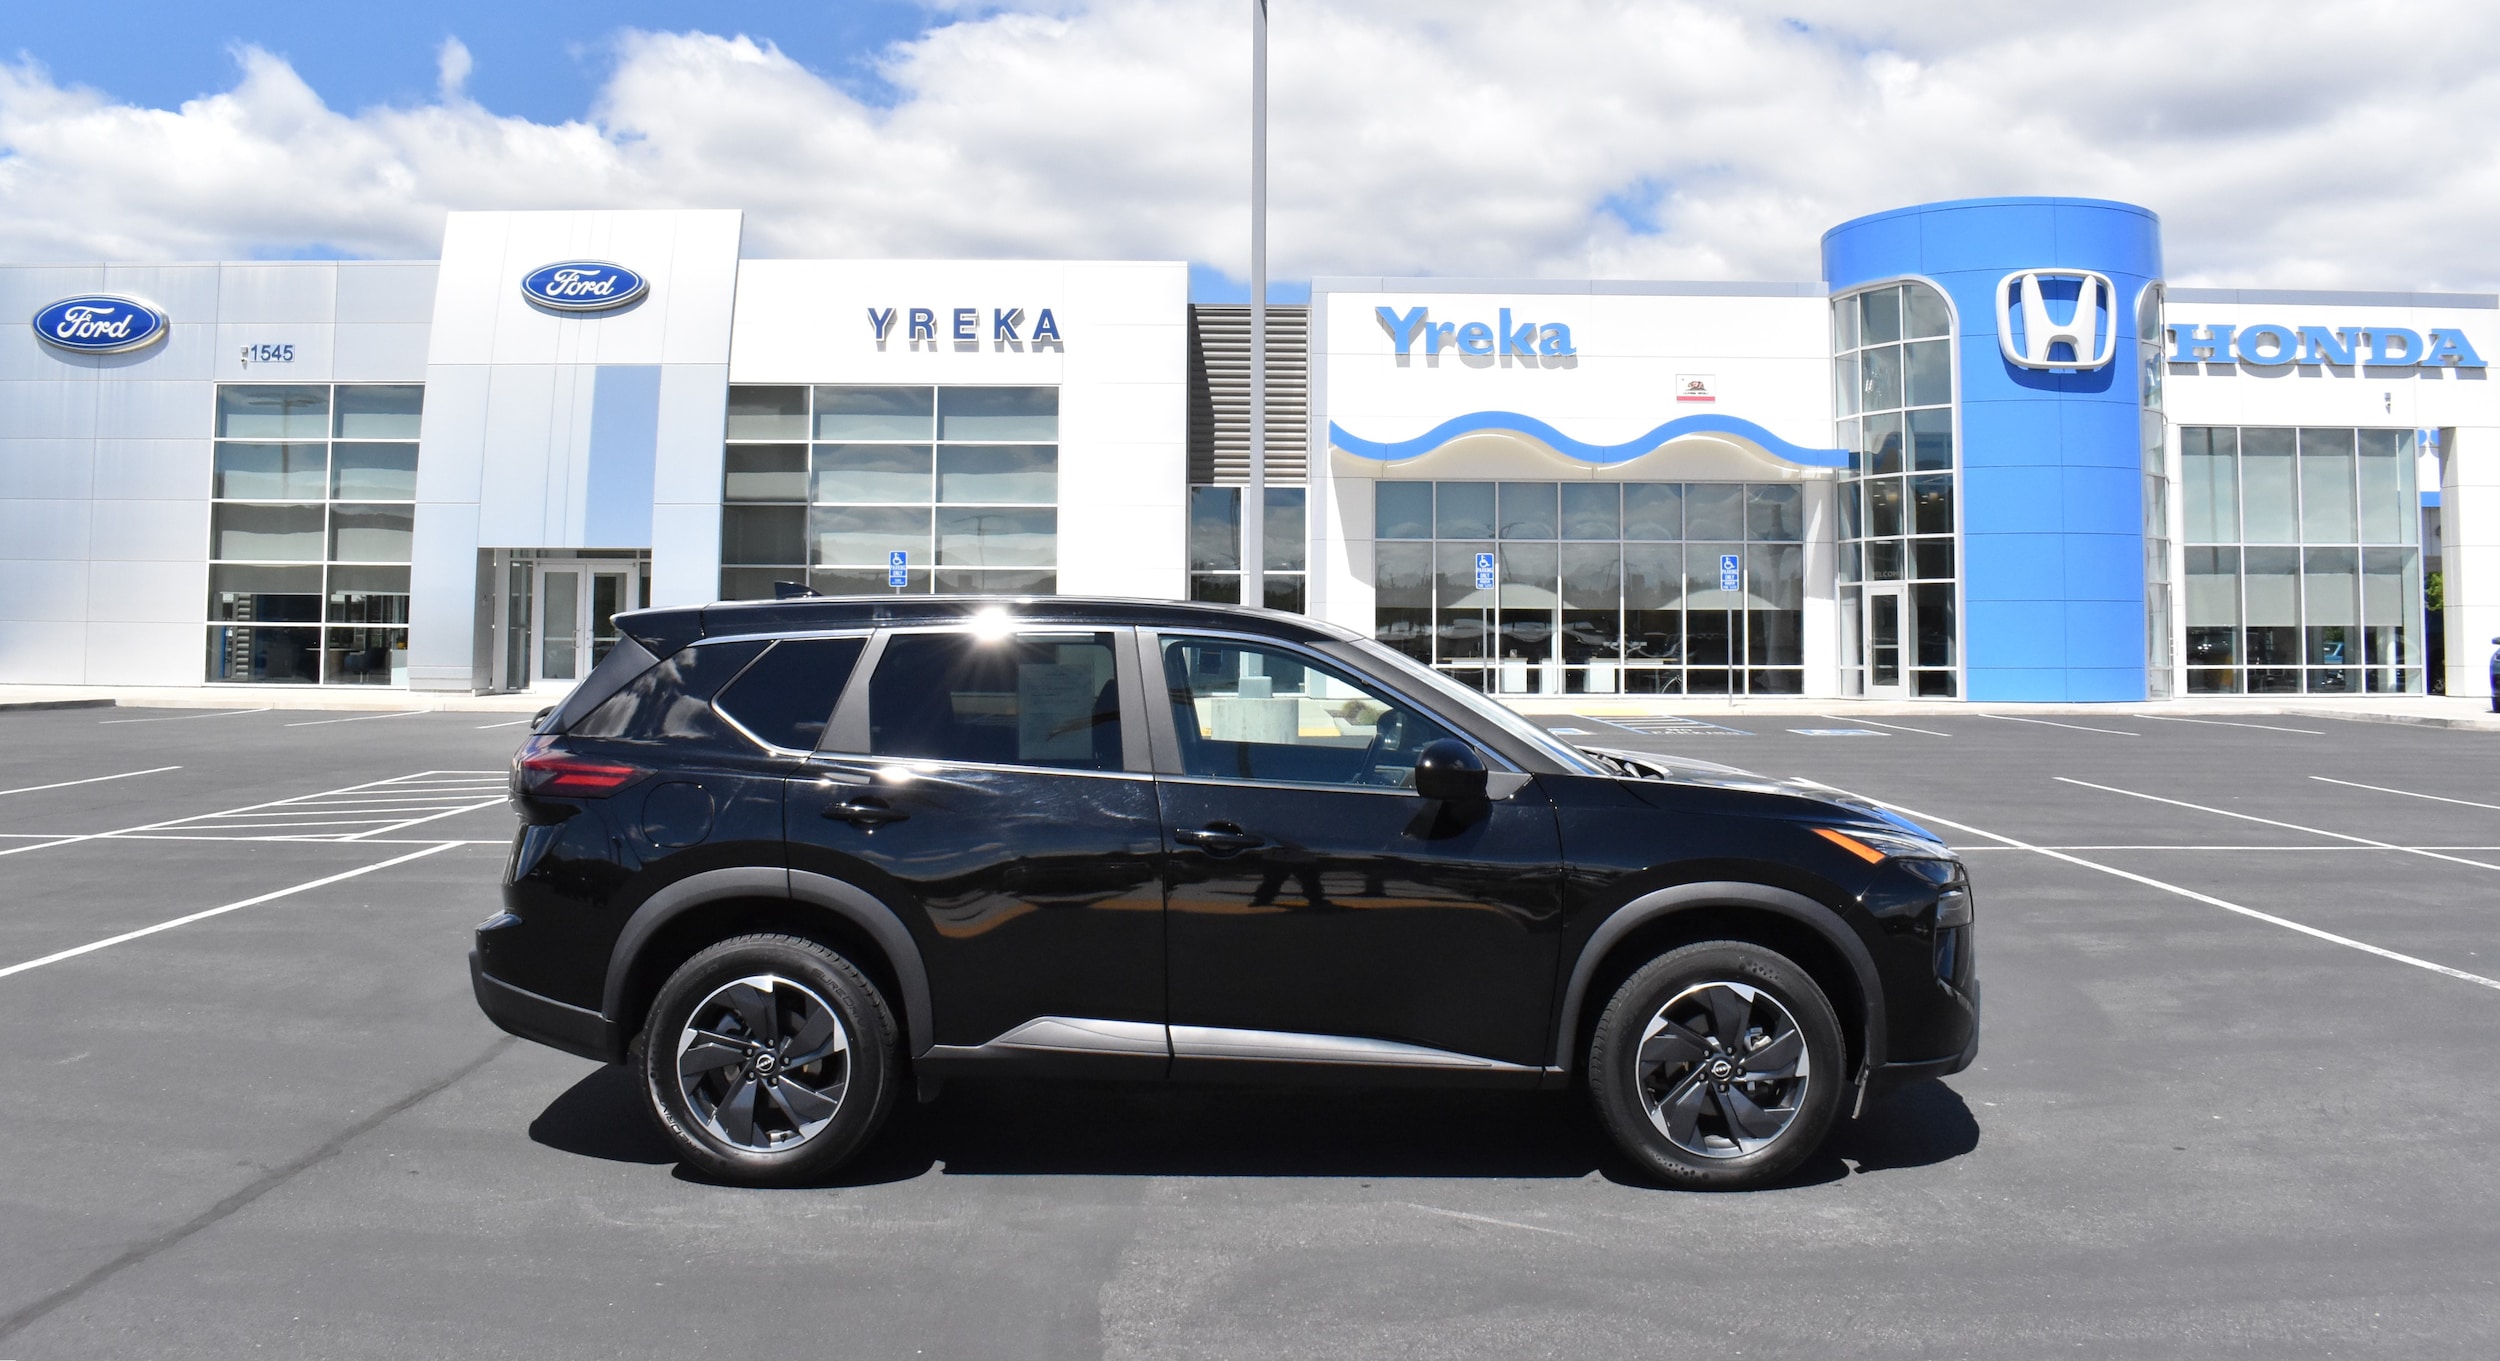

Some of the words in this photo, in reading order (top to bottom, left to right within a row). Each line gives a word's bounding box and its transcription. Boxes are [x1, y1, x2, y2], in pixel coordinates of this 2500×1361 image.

[546, 268, 618, 296] Ford
[56, 305, 134, 339] Ford
[866, 307, 1063, 343] YREKA
[1374, 306, 1577, 356] Yreka
[250, 344, 294, 362] 1545
[2167, 323, 2488, 368] HONDA
